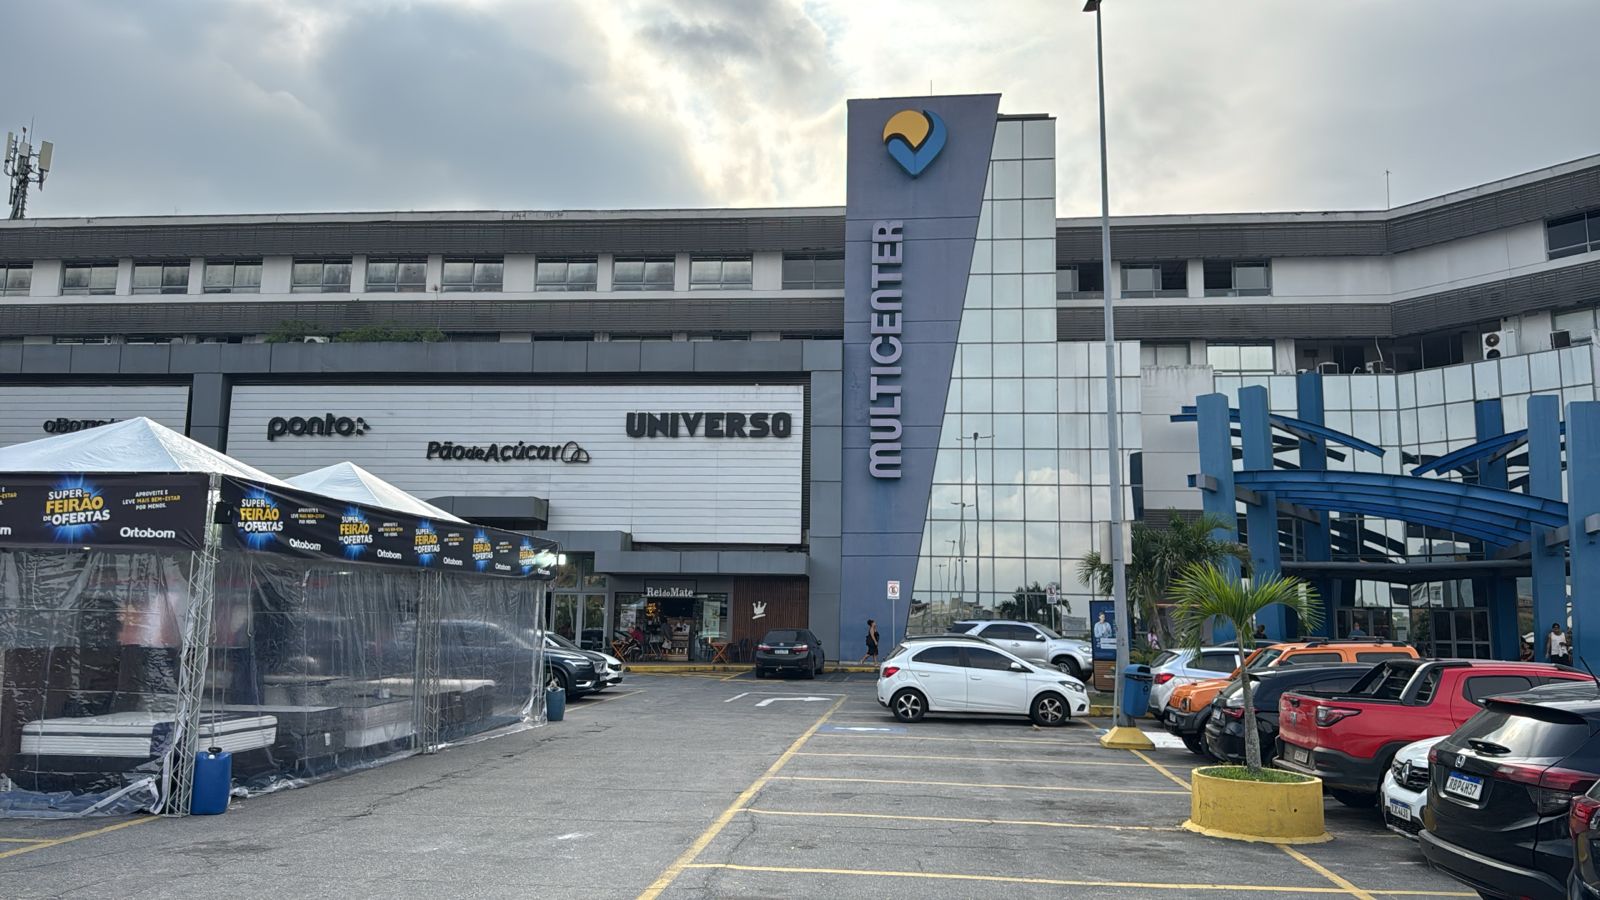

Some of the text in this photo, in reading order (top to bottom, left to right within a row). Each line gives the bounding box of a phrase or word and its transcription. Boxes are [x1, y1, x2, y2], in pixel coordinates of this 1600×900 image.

[869, 220, 903, 479] MULTICENTER
[626, 412, 792, 438] UNIVERSO
[49, 489, 83, 500] SUPER
[46, 493, 104, 514] FEIRÃO
[241, 499, 265, 507] SUPER
[52, 509, 110, 525] OFERTAS
[240, 504, 280, 520] FEIRÃO
[244, 521, 284, 532] OFERTAS
[340, 521, 369, 535] FEIRÃO
[120, 527, 176, 538] Ortobom
[289, 538, 321, 550] Ortobom
[343, 534, 373, 544] OFERTAS
[377, 549, 402, 559] Ortobom
[418, 544, 440, 553] OFERTAS
[443, 557, 463, 566] Ortobom
